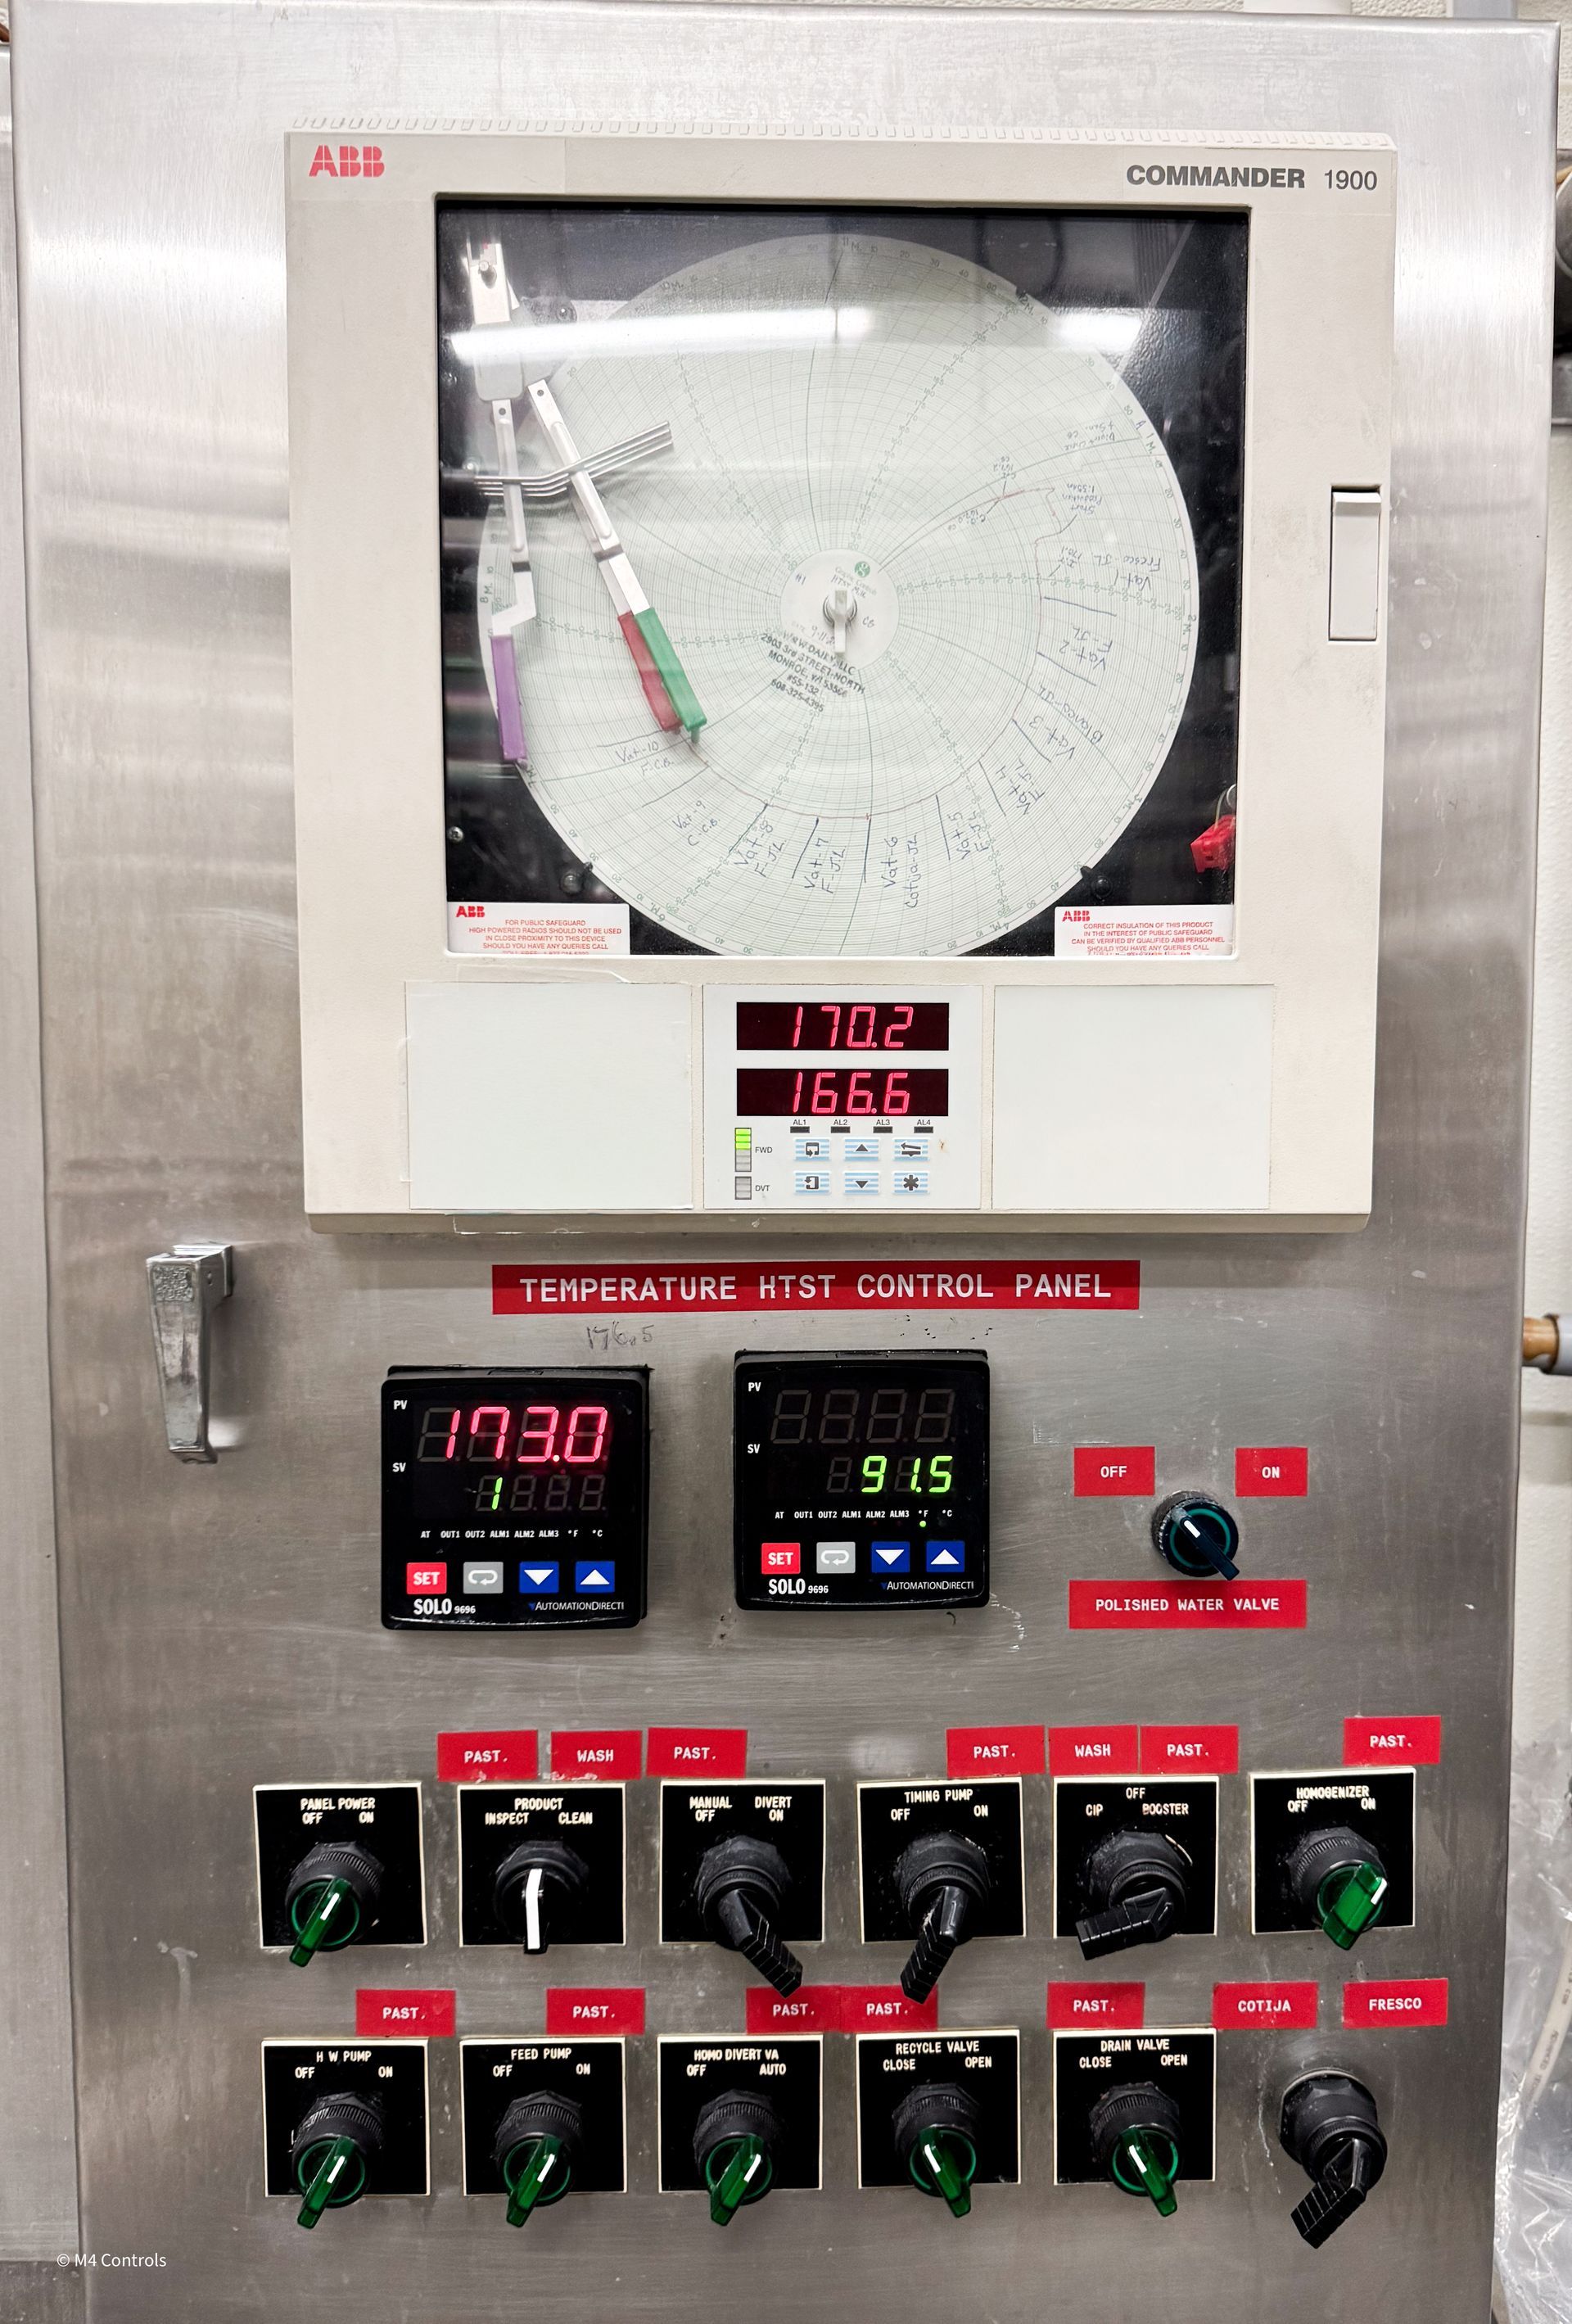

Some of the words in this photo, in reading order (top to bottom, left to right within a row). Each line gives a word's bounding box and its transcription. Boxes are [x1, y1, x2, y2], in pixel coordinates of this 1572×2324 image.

[308, 144, 386, 178] ABB
[1126, 164, 1306, 190] COMMANDER
[1323, 169, 1379, 192] 1900
[455, 905, 486, 918] ABB
[1061, 910, 1091, 922] ABB
[793, 1006, 914, 1048] 170.2
[793, 1071, 910, 1114] 166.6
[793, 1119, 807, 1127] AL1
[833, 1119, 848, 1127] AL2
[875, 1119, 891, 1127] AL3
[915, 1119, 932, 1127] AL4
[755, 1184, 770, 1192] DVT
[519, 1276, 738, 1304] TEMPERATURE
[758, 1273, 837, 1300] HTST
[856, 1273, 994, 1299] CONTROL
[1014, 1273, 1112, 1299] PANEL
[748, 1381, 761, 1392] PV
[393, 1399, 408, 1410] PV
[445, 1405, 609, 1463] 173.0
[747, 1443, 761, 1454] SV
[392, 1462, 406, 1472] SV
[861, 1454, 953, 1494] 91.5
[1100, 1465, 1128, 1478] OFF
[1261, 1466, 1281, 1479] ON
[491, 1476, 504, 1510] 1
[775, 1511, 784, 1519] AT
[793, 1510, 814, 1519] OUT1
[817, 1510, 838, 1519] OUT2
[842, 1510, 861, 1518] ALM1
[865, 1510, 886, 1518] ALM2
[889, 1510, 910, 1518] ALM3
[420, 1530, 431, 1538] AT
[440, 1530, 460, 1538] OUT1
[464, 1530, 486, 1538] OUT2
[490, 1530, 510, 1538] ALM1
[513, 1530, 535, 1538] ALM2
[538, 1530, 560, 1538] ALM3
[767, 1552, 794, 1566] SET
[413, 1571, 440, 1585] SET
[768, 1578, 806, 1595] SOLO
[807, 1584, 829, 1594] 9696
[413, 1598, 452, 1615] SOLO
[454, 1605, 477, 1615] 9696
[1095, 1598, 1170, 1612] POLISHED
[1177, 1598, 1225, 1612] WATER
[1233, 1598, 1281, 1612] VALVE
[1369, 1734, 1413, 1749] PAST.
[463, 1749, 508, 1764] PAST.
[576, 1748, 615, 1764] WASH
[673, 1746, 716, 1761] PAST.
[973, 1744, 1017, 1759] PAST.
[1074, 1743, 1112, 1758] WASH
[1166, 1743, 1210, 1757] PAST.
[903, 1790, 942, 1803] TIMING
[944, 1788, 974, 1802] PUMP
[1125, 1787, 1146, 1800] OFF
[1295, 1784, 1371, 1800] HOMOGENIZER
[300, 1797, 336, 1811] PANEL
[337, 1797, 377, 1810] POWER
[513, 1797, 564, 1811] PRODUCT
[689, 1795, 733, 1810] MANUAL
[753, 1795, 793, 1810] DIVERT
[1085, 1803, 1104, 1817] CIP
[1141, 1802, 1189, 1816] BOOSTER
[1286, 1799, 1309, 1815] OFF
[1360, 1797, 1377, 1810] ON
[301, 1811, 323, 1824] OFF
[358, 1810, 375, 1824] ON
[485, 1811, 529, 1826] INSPECT
[558, 1811, 594, 1825] CLEAN
[694, 1808, 716, 1823] OFF
[768, 1808, 784, 1823] ON
[889, 1807, 910, 1821] OFF
[973, 1804, 989, 1818] ON
[772, 2003, 815, 2018] PAST.
[865, 2002, 909, 2016] PAST.
[1073, 1998, 1116, 2013] PAST.
[1236, 1998, 1292, 2013] COTIJA
[1368, 1996, 1423, 2011] FRESCO
[382, 2006, 427, 2021] PAST.
[572, 2005, 616, 2019] PAST.
[895, 2041, 942, 2055] RECYCLE
[946, 2039, 981, 2053] VALVE
[1100, 2039, 1133, 2052] DRAIN
[1136, 2037, 1171, 2051] VALVE
[316, 2050, 323, 2064] H
[328, 2050, 339, 2064] W
[342, 2049, 372, 2064] PUMP
[510, 2048, 540, 2062] FEED
[542, 2047, 573, 2060] PUMP
[693, 2049, 724, 2062] HOMO
[724, 2048, 762, 2061] DIVERT
[763, 2047, 779, 2060] VA
[1078, 2055, 1113, 2069] CLOSE
[1160, 2054, 1189, 2067] OPEN
[492, 2064, 513, 2078] OFF
[575, 2062, 591, 2076] ON
[686, 2064, 707, 2077] OFF
[758, 2062, 787, 2077] AUTO
[883, 2058, 917, 2072] CLOSE
[964, 2055, 992, 2070] OPEN
[294, 2065, 315, 2080] OFF
[377, 2065, 393, 2078] ON
